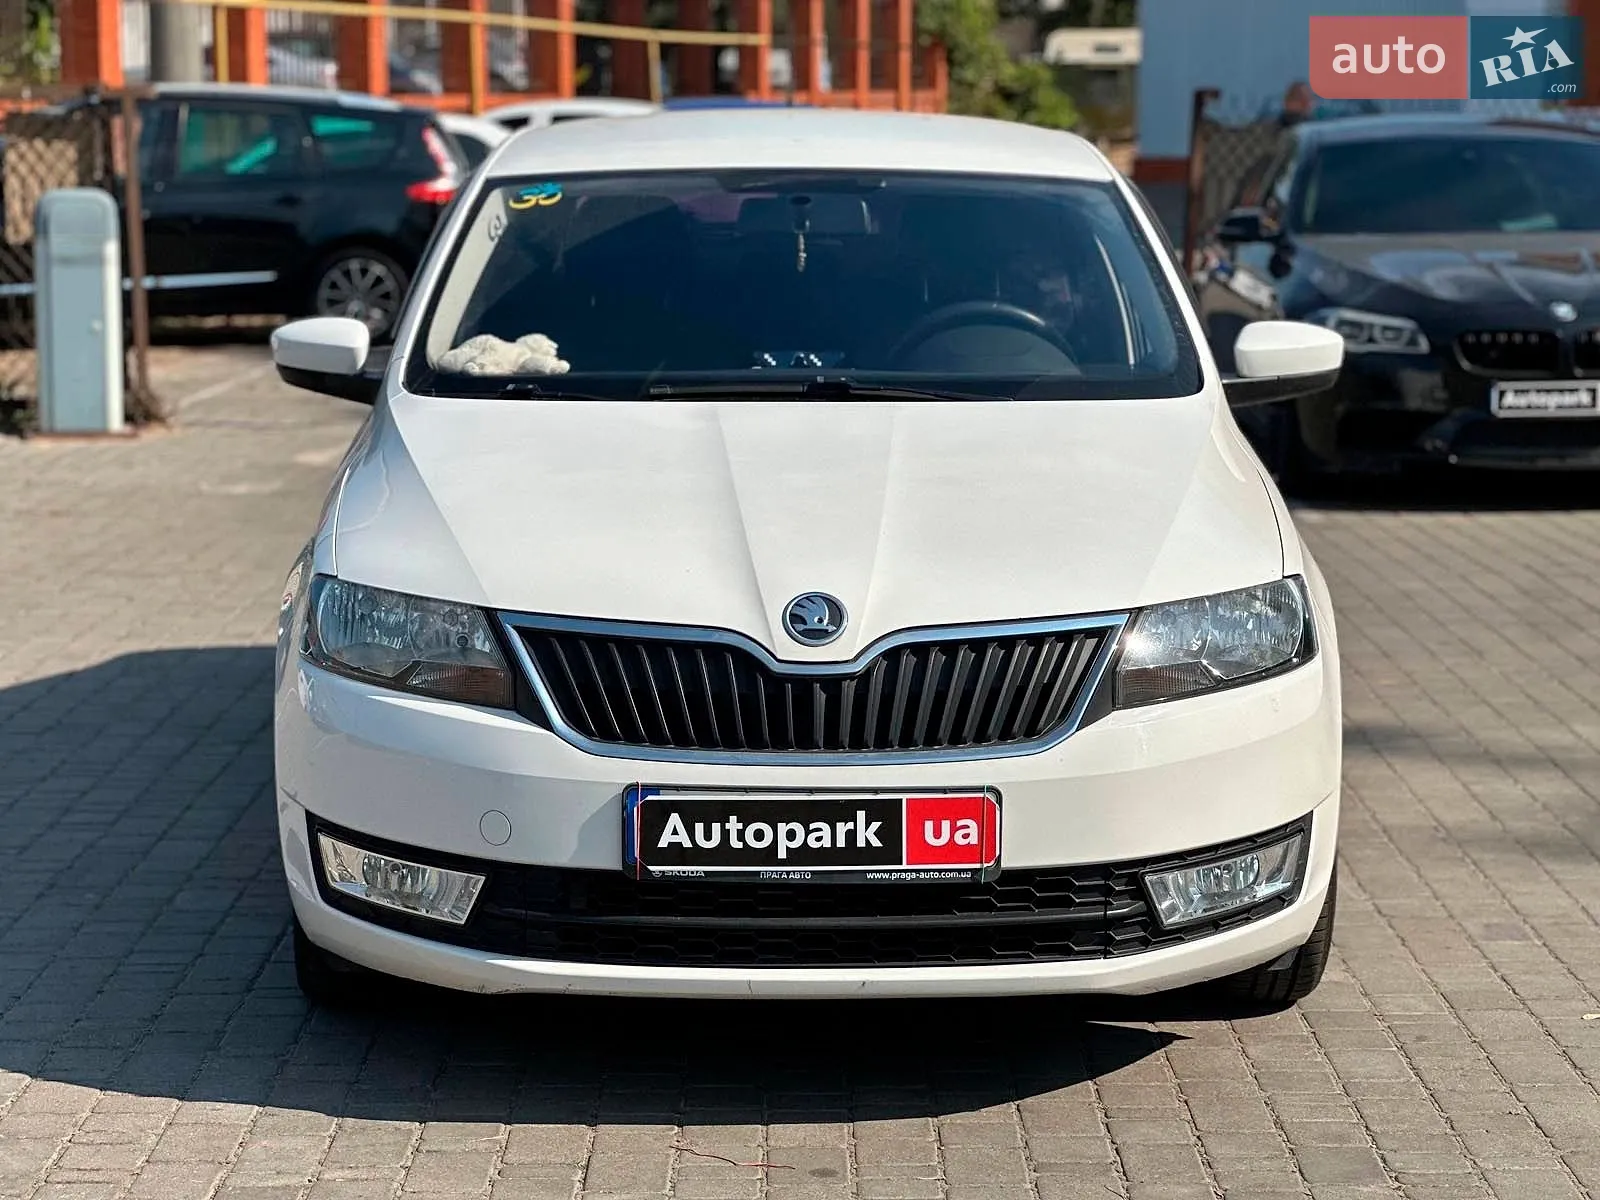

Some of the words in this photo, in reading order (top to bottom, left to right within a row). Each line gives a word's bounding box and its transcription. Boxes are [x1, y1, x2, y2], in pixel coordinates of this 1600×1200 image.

[1500, 388, 1594, 411] Autopark
[657, 810, 882, 859] Autopark
[924, 818, 979, 846] ua
[760, 871, 787, 879] ПРАГА
[788, 871, 811, 879] АВТО
[866, 871, 972, 880] www.praga-auto.com.ua
